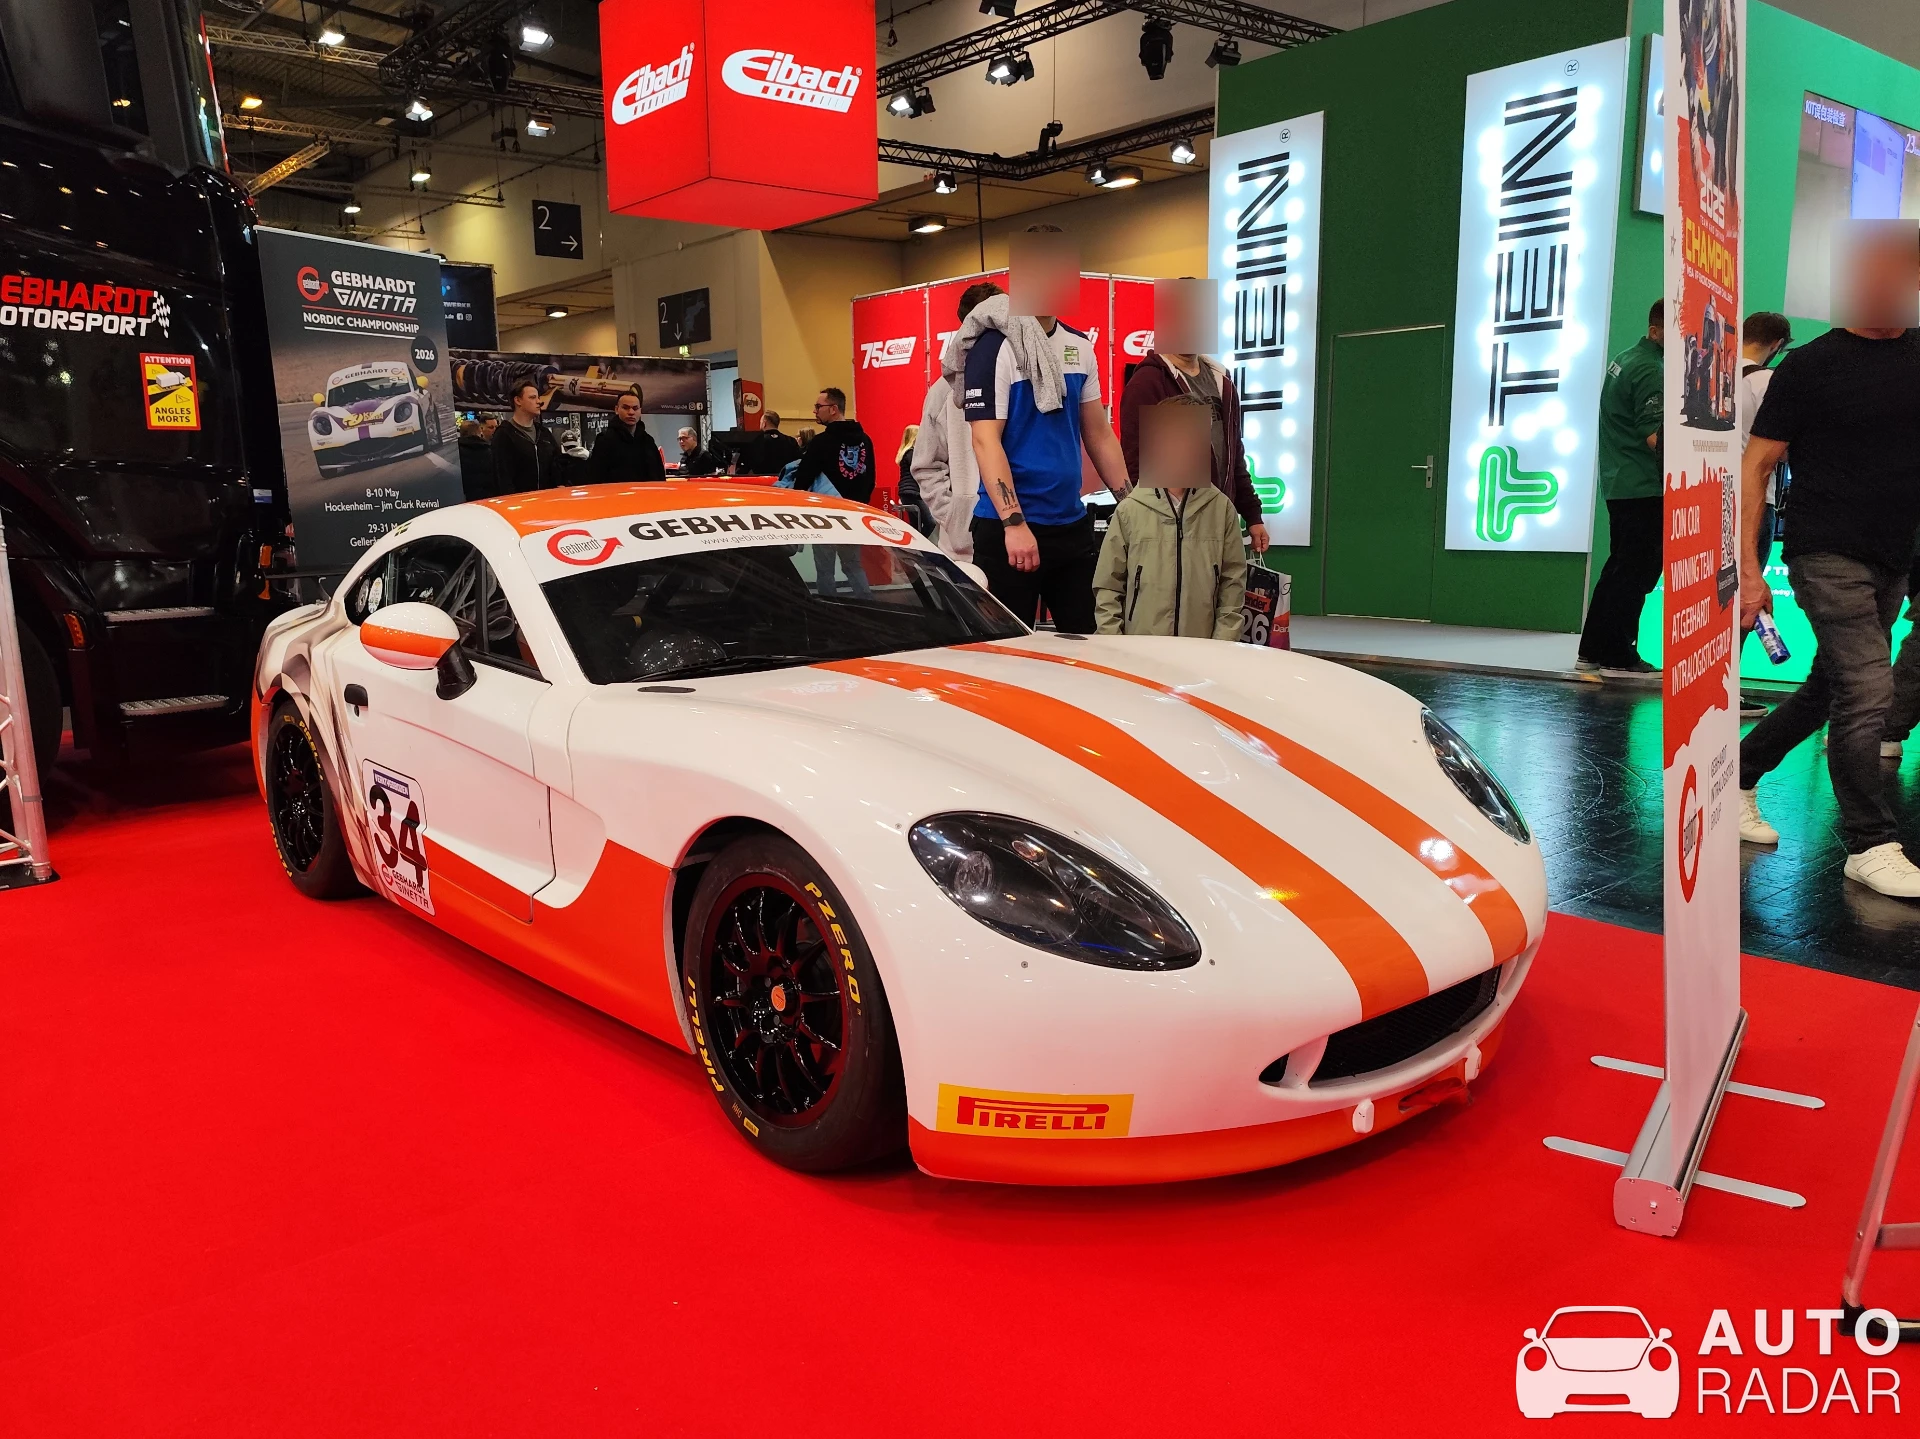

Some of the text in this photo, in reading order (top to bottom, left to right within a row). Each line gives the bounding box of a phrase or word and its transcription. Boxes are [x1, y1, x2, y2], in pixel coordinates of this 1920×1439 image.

[612, 42, 694, 125] Eibach
[722, 48, 861, 113] Eibach
[1699, 172, 1725, 230] 2025
[537, 205, 552, 230] 2
[1488, 86, 1578, 427] TEIN
[1685, 216, 1735, 292] CHAMPION
[0, 274, 154, 316] EBHARDT
[331, 270, 416, 295] GEBHARDT
[1233, 152, 1290, 439] TEIN
[333, 287, 418, 313] GINETTA
[659, 302, 669, 324] 2
[0, 305, 152, 337] OTORSPORT
[303, 311, 420, 334] NORDIC CHAMPIONSHIP
[144, 355, 192, 365] ATTENTION
[414, 348, 435, 361] 2026
[344, 368, 389, 380] GEBHARDT
[154, 407, 192, 415] ANGLES
[157, 415, 191, 423] MORTS
[324, 502, 373, 512] Hockenheim
[381, 500, 393, 513] Jim
[394, 500, 414, 510] Clark
[415, 498, 440, 509] Revival
[365, 487, 400, 500] 8-10 May
[367, 523, 389, 534] 29-31
[628, 513, 853, 541] GEBHARDT
[1670, 504, 1701, 541] JOIN OUR
[560, 538, 601, 556] gebhardt
[700, 532, 824, 546] www.gebhardt-group.se
[1670, 554, 1700, 593] WINNING
[1700, 549, 1715, 582] TEAM
[1671, 612, 1682, 645] AT
[1681, 596, 1711, 639] GEBHARDT
[1671, 642, 1717, 697] INTRALOGISTICS
[1715, 626, 1731, 665] GROUP
[370, 784, 428, 888] 34
[391, 869, 426, 897] GEBHARDT
[687, 975, 725, 1093] PIRELLI
[957, 1096, 1110, 1131] PIRELLI
